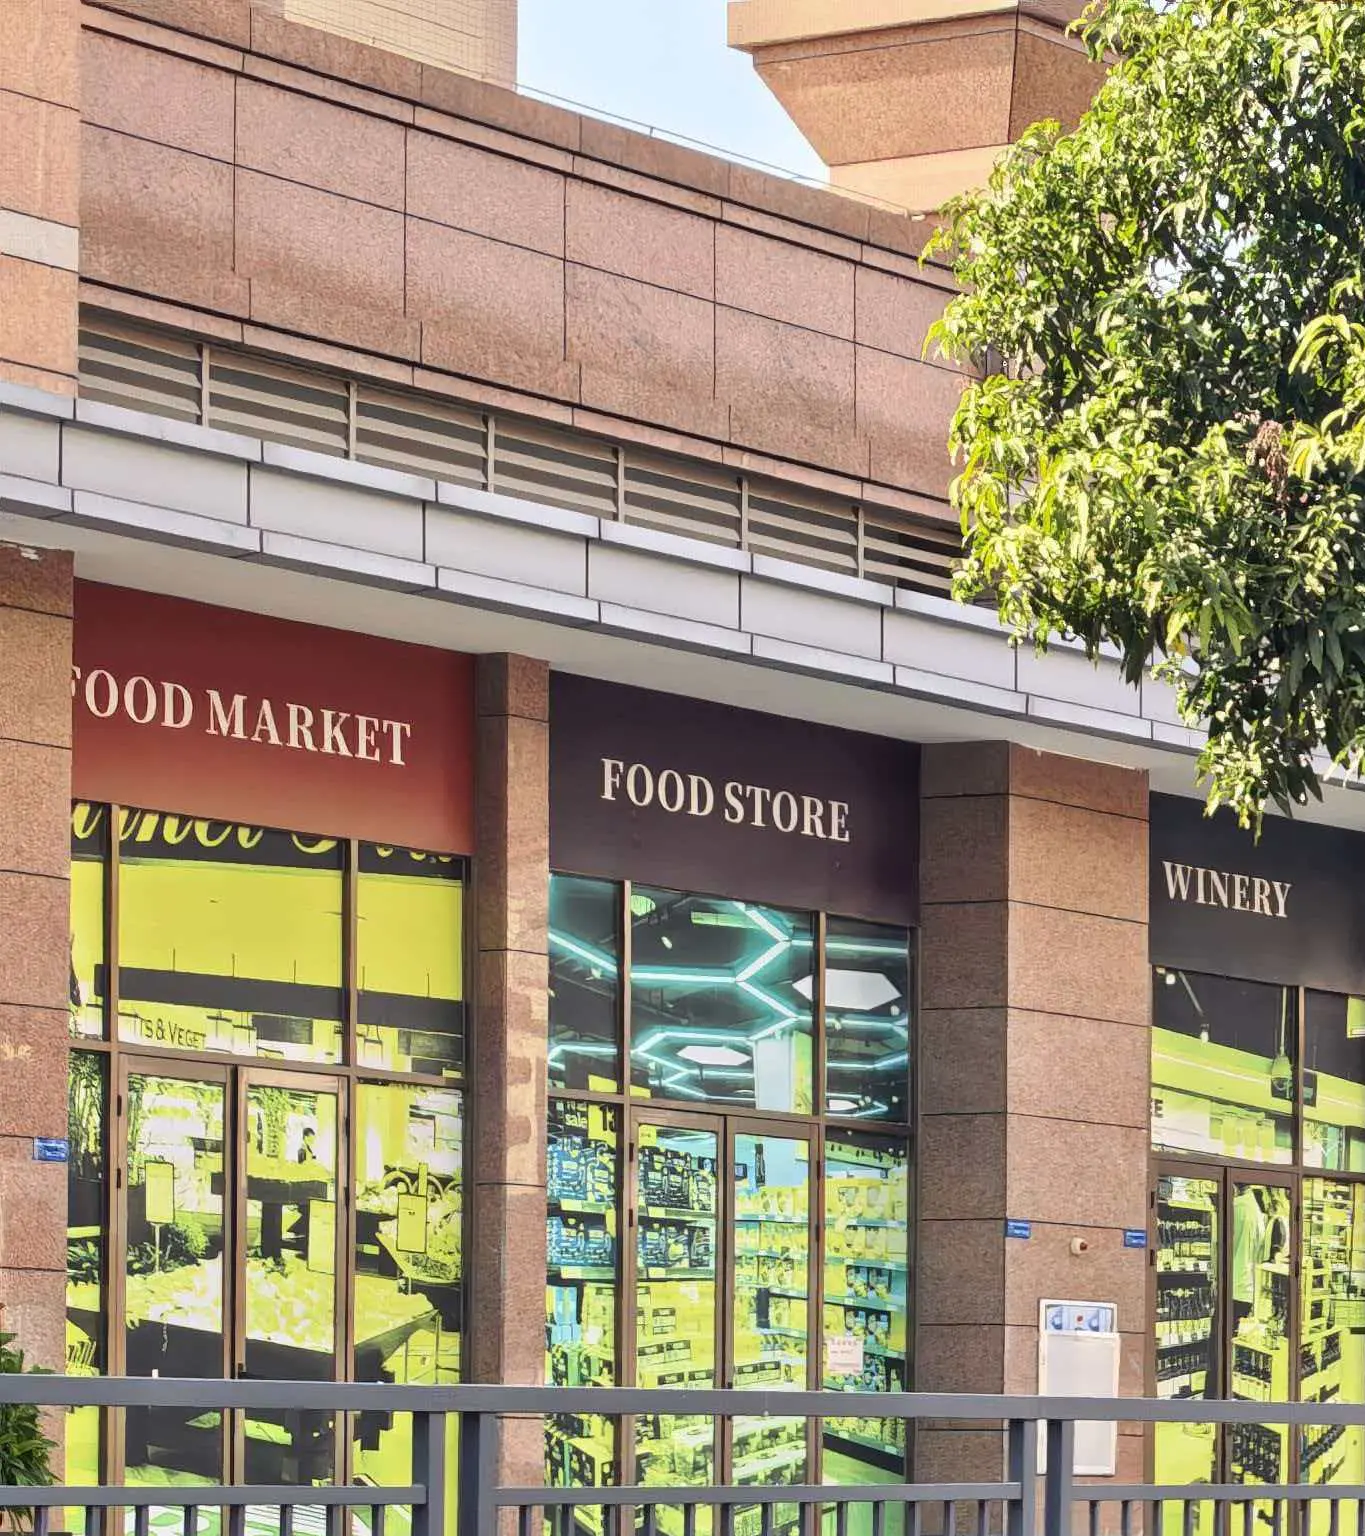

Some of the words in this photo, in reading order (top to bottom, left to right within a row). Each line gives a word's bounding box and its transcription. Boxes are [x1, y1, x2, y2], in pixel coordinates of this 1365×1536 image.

[205, 688, 411, 766] MARKET
[601, 758, 714, 816] FOOD
[724, 781, 850, 842] STORE
[1162, 860, 1292, 918] WINERY
